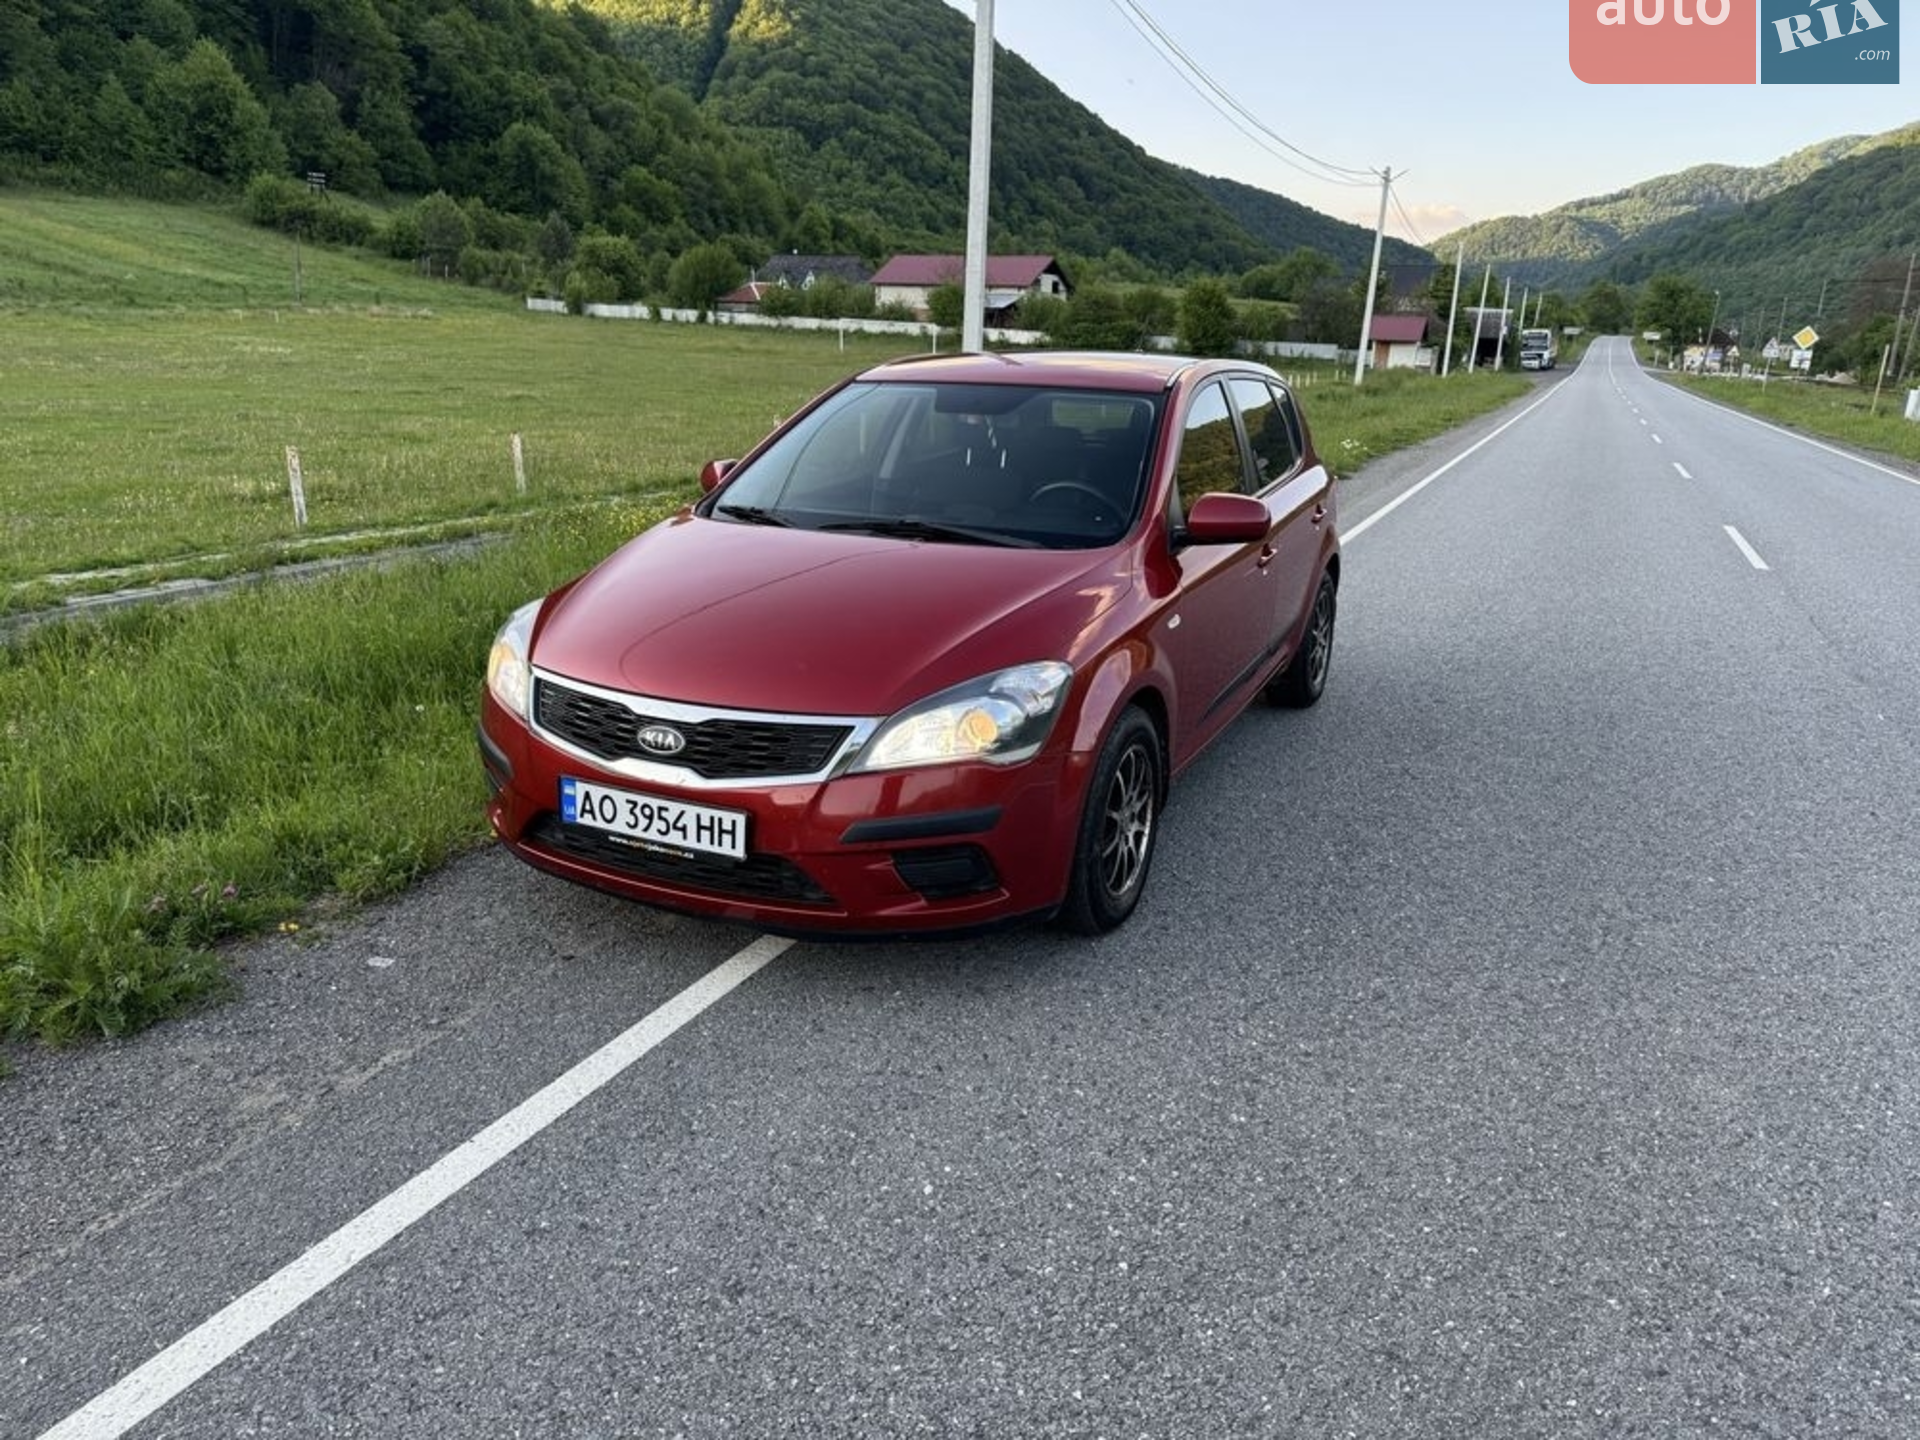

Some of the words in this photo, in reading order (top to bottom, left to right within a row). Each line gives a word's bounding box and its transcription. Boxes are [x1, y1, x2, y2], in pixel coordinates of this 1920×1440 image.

[645, 731, 676, 750] KIA
[579, 790, 617, 824] AO
[625, 798, 688, 840] 3954
[696, 813, 736, 850] HH
